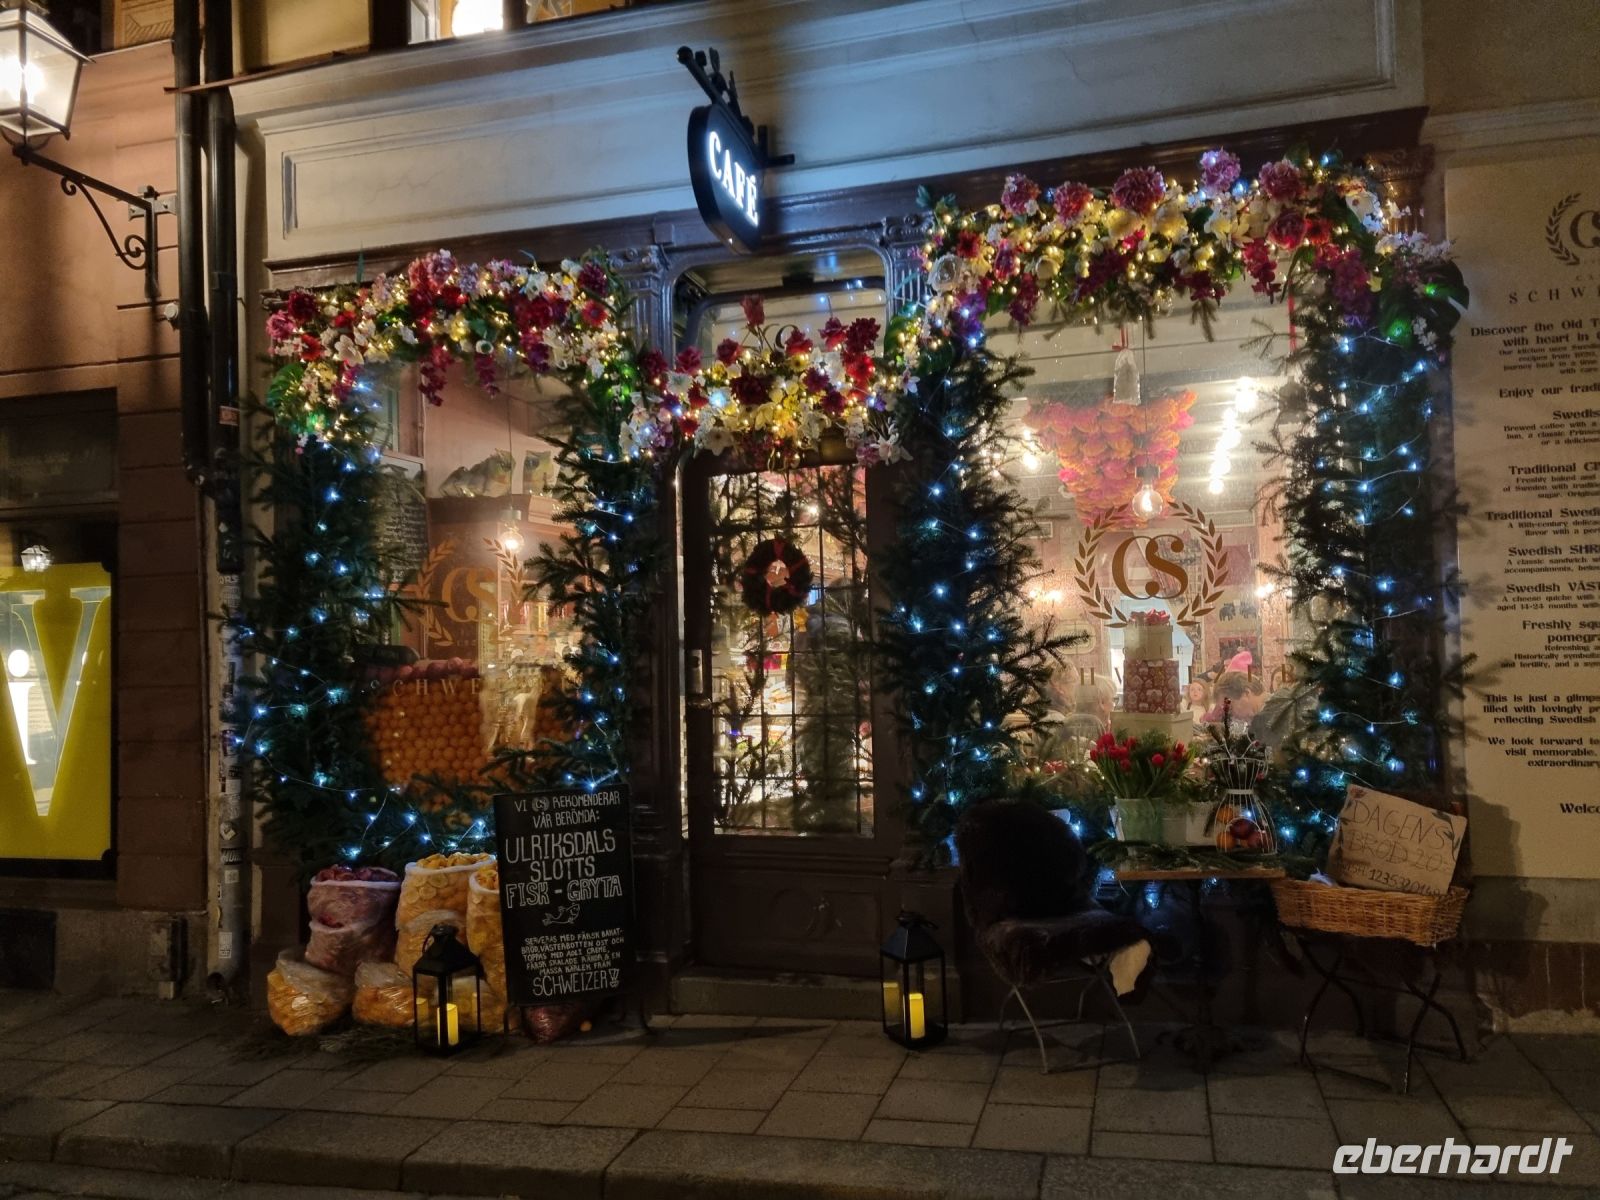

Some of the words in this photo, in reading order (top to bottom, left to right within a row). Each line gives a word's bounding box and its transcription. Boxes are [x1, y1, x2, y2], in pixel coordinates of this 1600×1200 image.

[708, 131, 759, 228] CAFÉ
[1471, 324, 1527, 337] Discover
[1534, 322, 1553, 332] the
[1561, 319, 1582, 330] Old
[1590, 317, 1600, 327] T
[1502, 336, 1529, 347] with
[1536, 333, 1569, 345] heart
[1577, 332, 1588, 342] in
[1499, 387, 1534, 399] Enjoy
[1541, 386, 1563, 395] our
[1552, 408, 1600, 420] Swedis
[1503, 424, 1536, 432] Brewed
[1508, 462, 1576, 475] Traditional
[1485, 508, 1553, 521] Traditional
[1508, 546, 1562, 557] Swedish
[1111, 533, 1189, 600] CS
[1506, 582, 1560, 594] Swedish
[1497, 604, 1516, 612] aged
[1522, 619, 1571, 631] Freshly
[1544, 644, 1590, 652] Refreshing
[1514, 652, 1559, 660] Historically
[1555, 660, 1569, 668] and
[1486, 694, 1508, 703] This
[1514, 694, 1522, 702] is
[1528, 694, 1547, 703] just
[1483, 705, 1508, 713] filled
[1514, 705, 1536, 713] with
[1542, 704, 1583, 714] lovingly
[1494, 715, 1544, 725] reflecting
[1550, 715, 1596, 724] Swedish
[1488, 737, 1505, 745] We
[1511, 737, 1534, 745] look
[1540, 737, 1583, 745] forward
[1505, 748, 1527, 756] visit
[1532, 747, 1598, 756] memorable.
[514, 799, 528, 812] VI
[533, 811, 552, 829] VÅR
[1350, 799, 1448, 850] DAGENS
[505, 828, 616, 864] ULRIKSDALS
[530, 855, 595, 882] SLOTTS
[506, 881, 550, 909] FISK
[567, 875, 623, 902] GRYTA
[560, 933, 575, 942] MED
